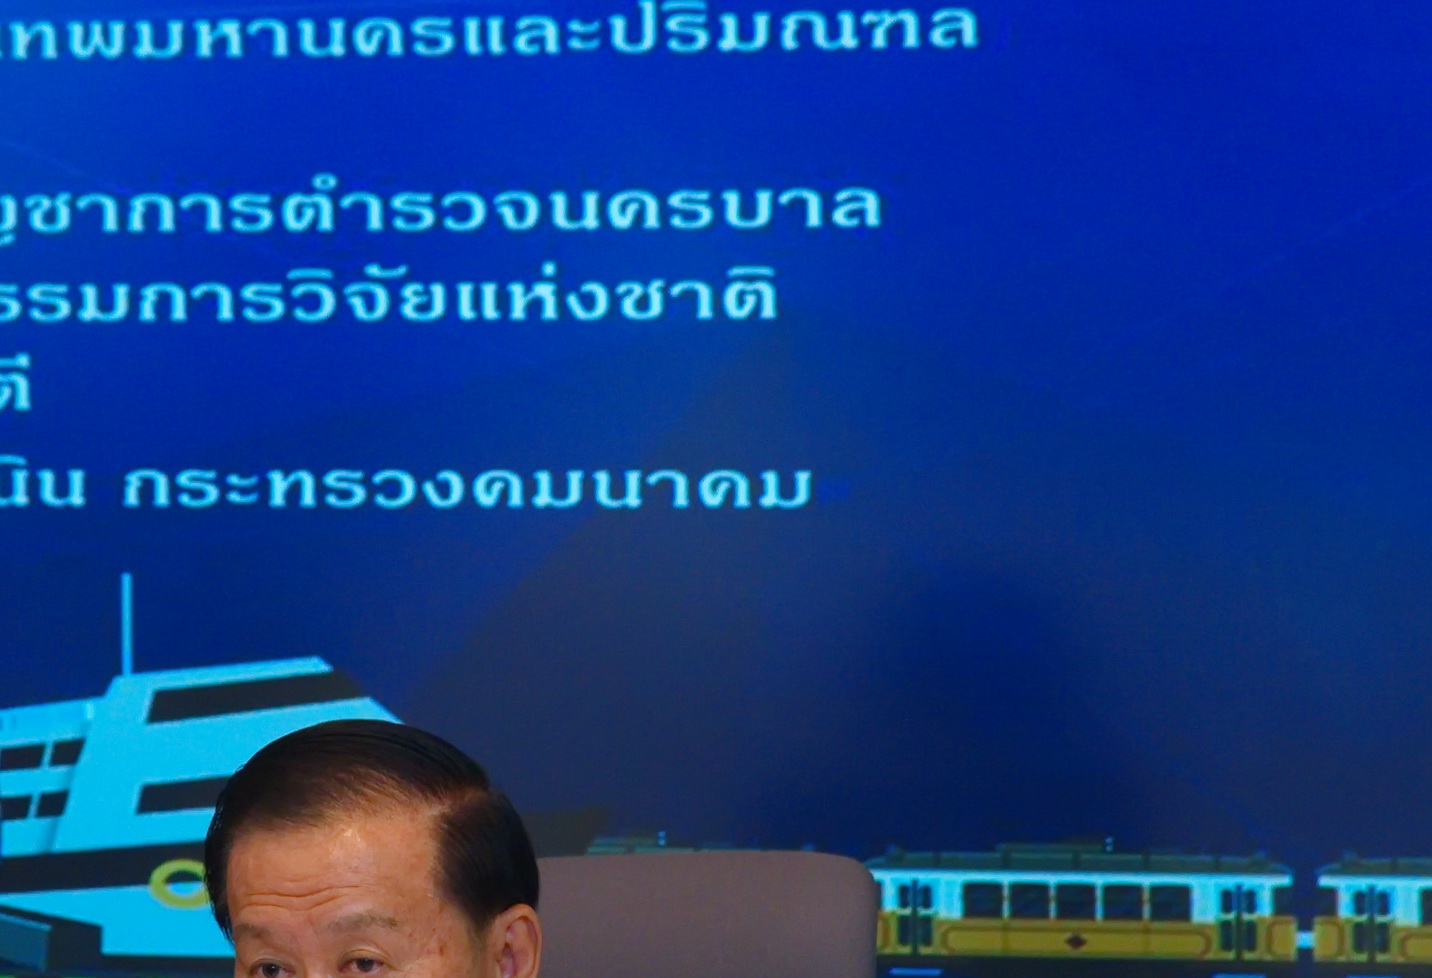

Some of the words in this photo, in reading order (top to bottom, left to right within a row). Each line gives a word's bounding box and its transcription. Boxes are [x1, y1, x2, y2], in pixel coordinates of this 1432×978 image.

[122, 467, 813, 511] กระทรวงคมนาคม
